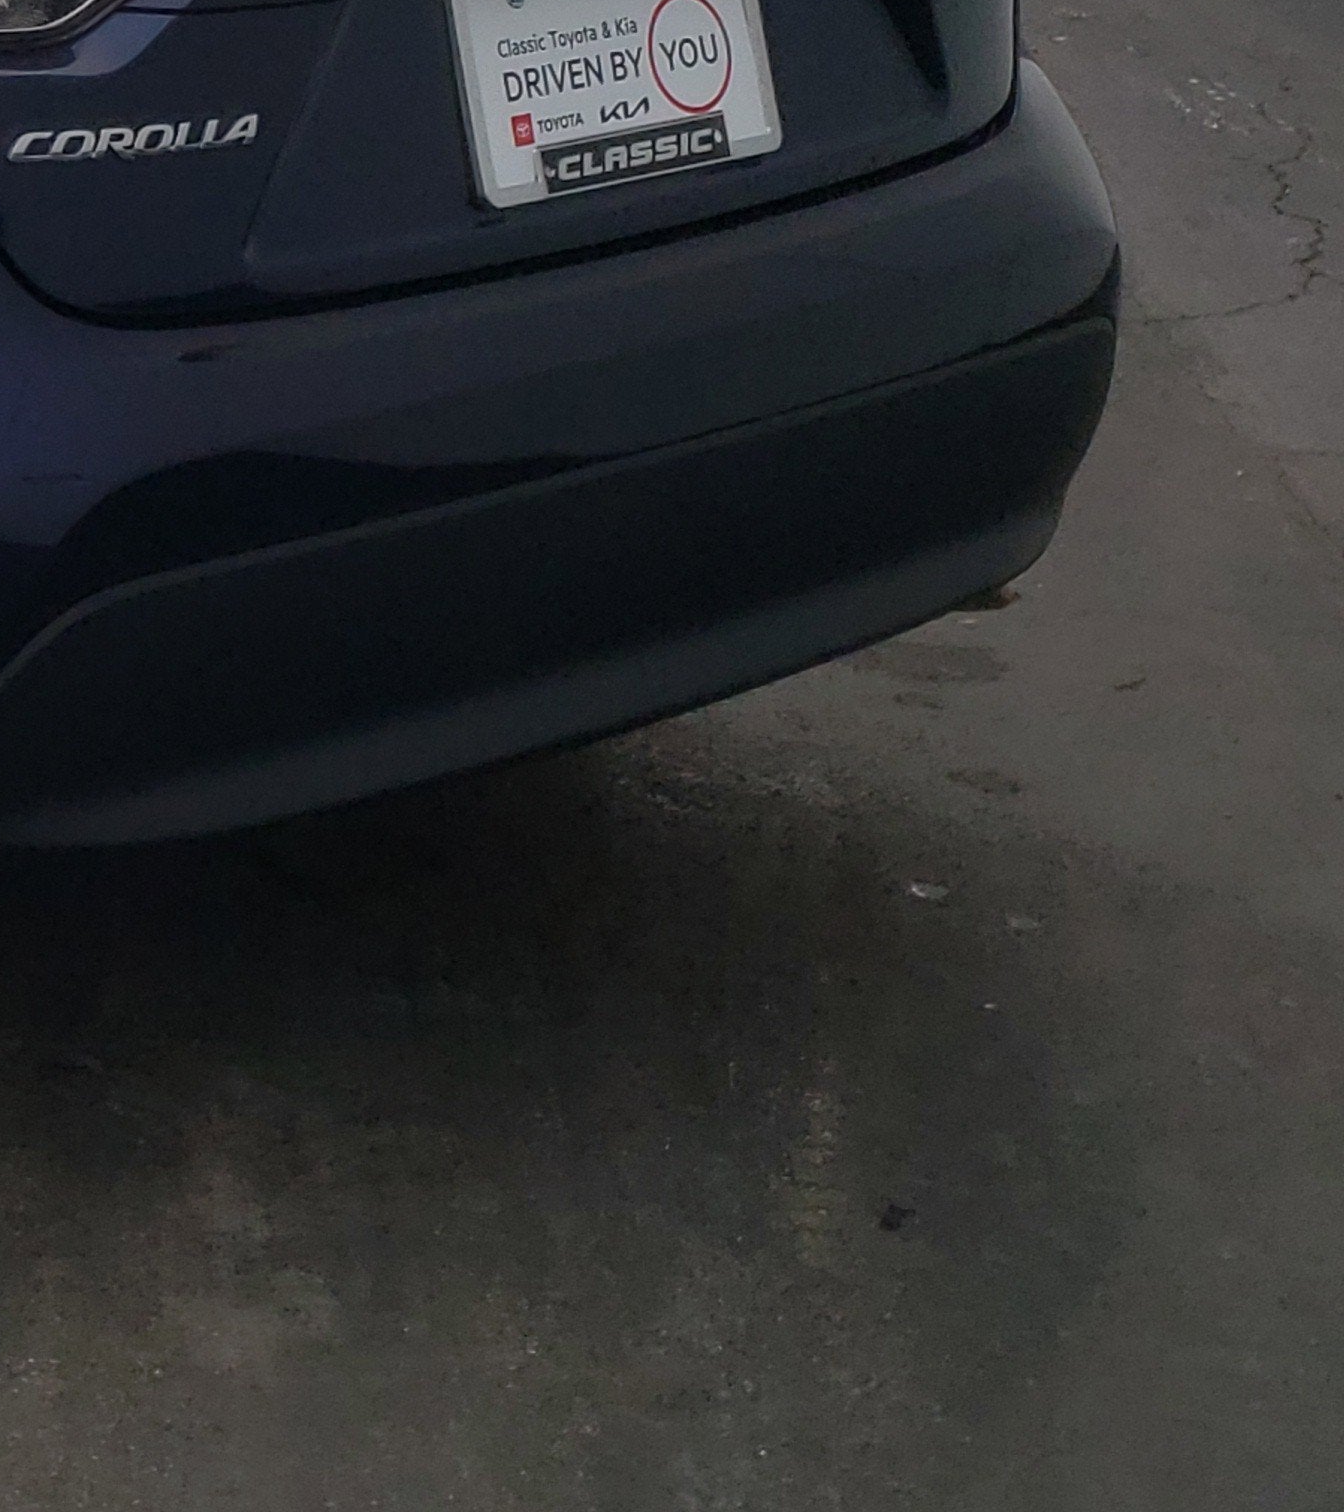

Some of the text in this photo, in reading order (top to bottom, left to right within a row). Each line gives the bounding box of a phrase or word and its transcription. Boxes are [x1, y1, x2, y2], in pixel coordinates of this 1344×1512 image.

[497, 17, 638, 58] Classic Toyota & Kia
[502, 33, 719, 103] DRIVEN BY YOU
[8, 113, 259, 162] COROLLA
[537, 113, 584, 134] TOYOTA
[558, 128, 713, 181] CLASSIC
